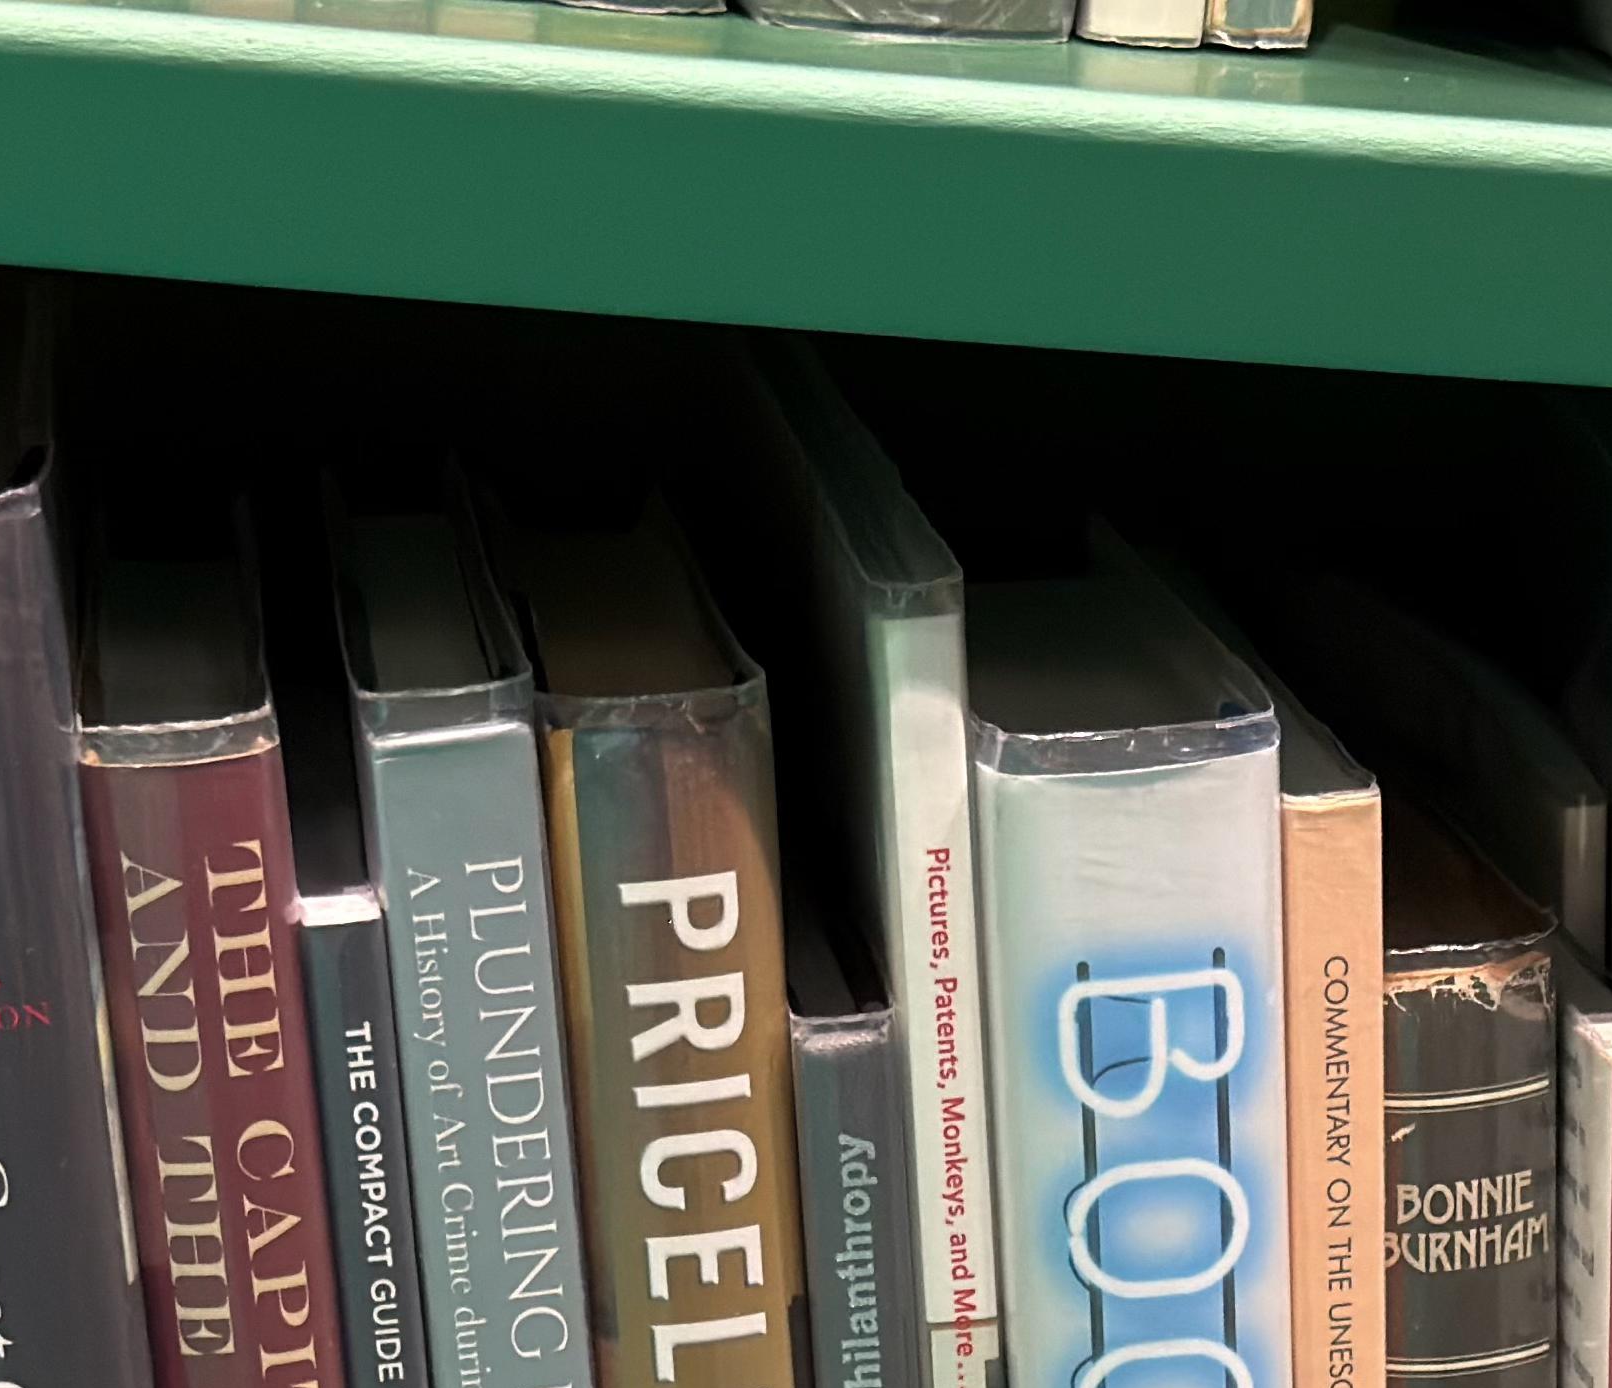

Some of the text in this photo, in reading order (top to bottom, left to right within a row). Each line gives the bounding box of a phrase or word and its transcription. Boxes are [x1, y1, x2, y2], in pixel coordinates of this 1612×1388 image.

[406, 867, 441, 899] A
[120, 852, 203, 1091] AND
[205, 839, 285, 1078] THE
[412, 910, 447, 1047] History
[344, 1021, 377, 1091] THE
[427, 1061, 462, 1099] of
[1324, 956, 1351, 1166] COMMENTARY
[353, 1101, 393, 1267] COMPACT
[433, 1114, 474, 1171] Art
[156, 1136, 235, 1355] THE
[440, 1183, 475, 1294] Crime
[1326, 1178, 1352, 1225] ON
[1397, 1170, 1534, 1225] BONNIE
[1328, 1239, 1352, 1291] THE
[370, 1281, 405, 1383] GUIDE
